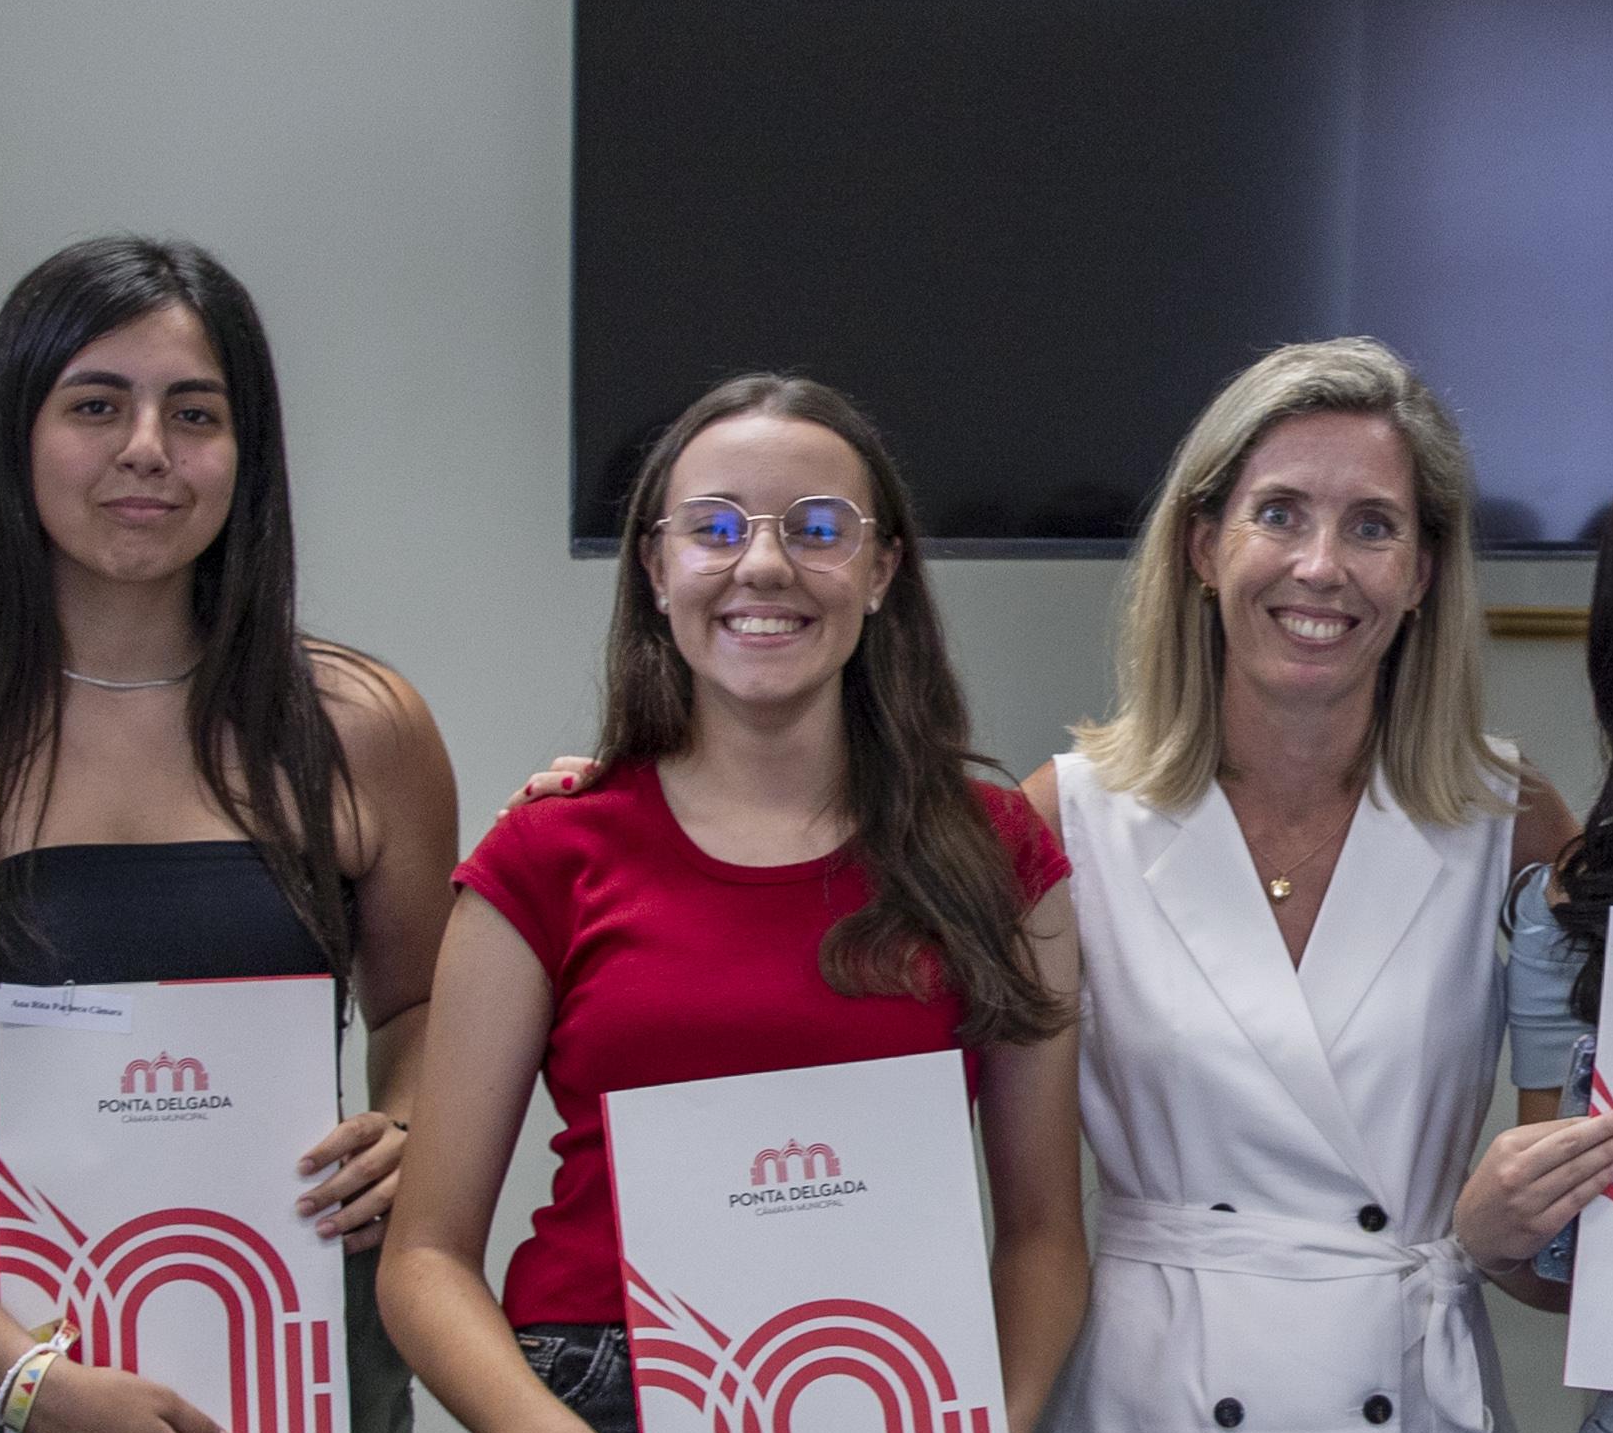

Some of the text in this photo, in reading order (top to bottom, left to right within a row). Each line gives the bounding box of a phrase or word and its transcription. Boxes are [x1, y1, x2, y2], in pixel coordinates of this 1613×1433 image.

[98, 1096, 233, 1112] PONTA DELGADA
[729, 1180, 867, 1207] PONTA DELGADA
